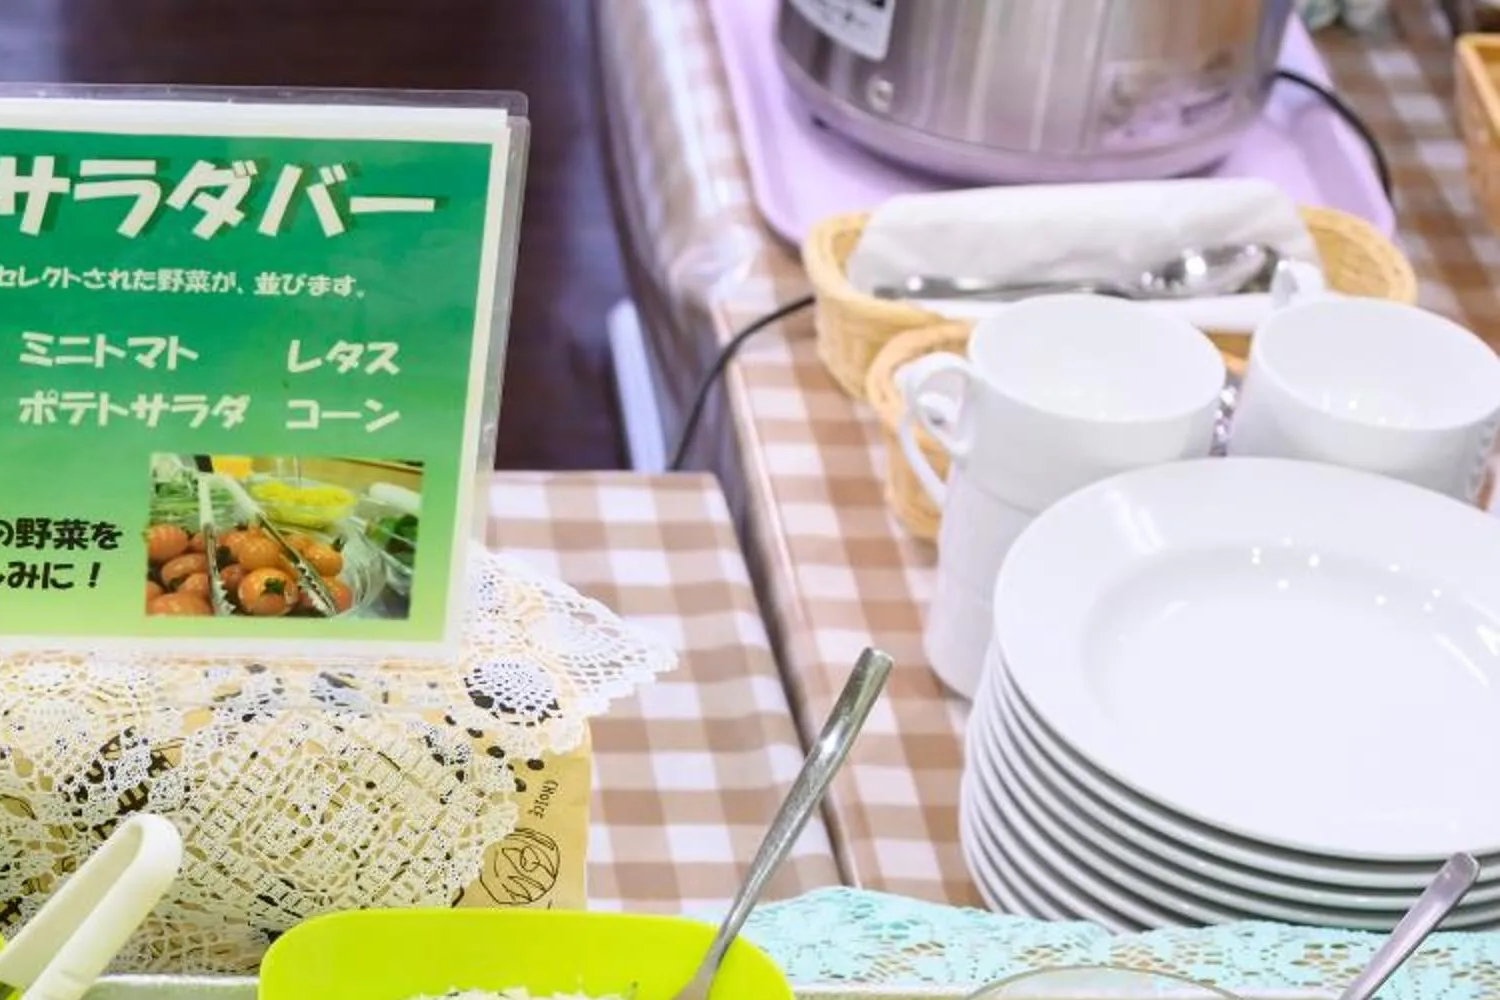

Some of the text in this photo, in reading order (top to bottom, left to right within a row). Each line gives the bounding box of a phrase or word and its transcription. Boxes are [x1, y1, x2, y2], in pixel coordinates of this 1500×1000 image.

[19, 331, 200, 371] ミニトマト
[286, 338, 401, 374] レタス
[19, 389, 251, 428] ポテトサラダ
[286, 397, 401, 433] コーン
